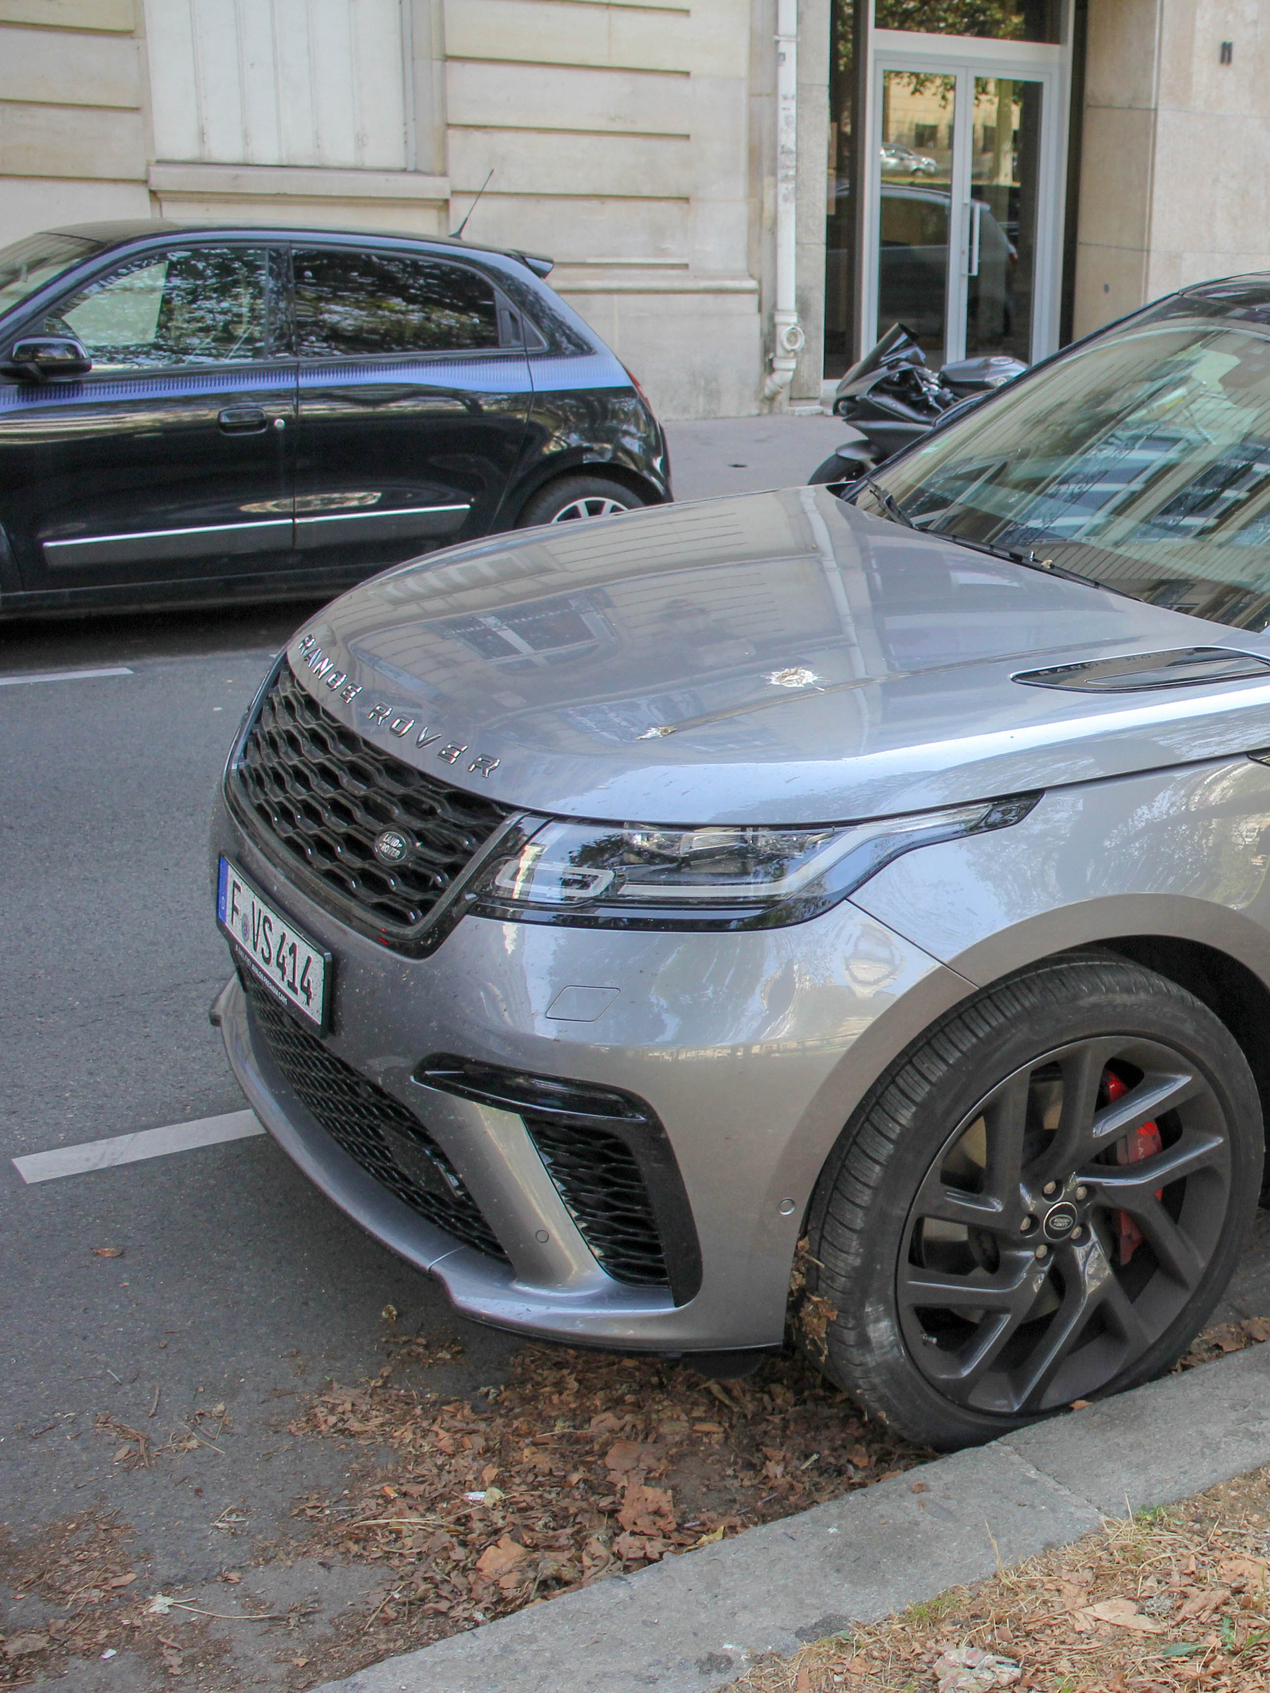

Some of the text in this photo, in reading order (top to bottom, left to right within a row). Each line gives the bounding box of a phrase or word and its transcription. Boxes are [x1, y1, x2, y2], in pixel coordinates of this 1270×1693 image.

[298, 633, 501, 778] RANGE ROVER
[231, 879, 242, 926] F
